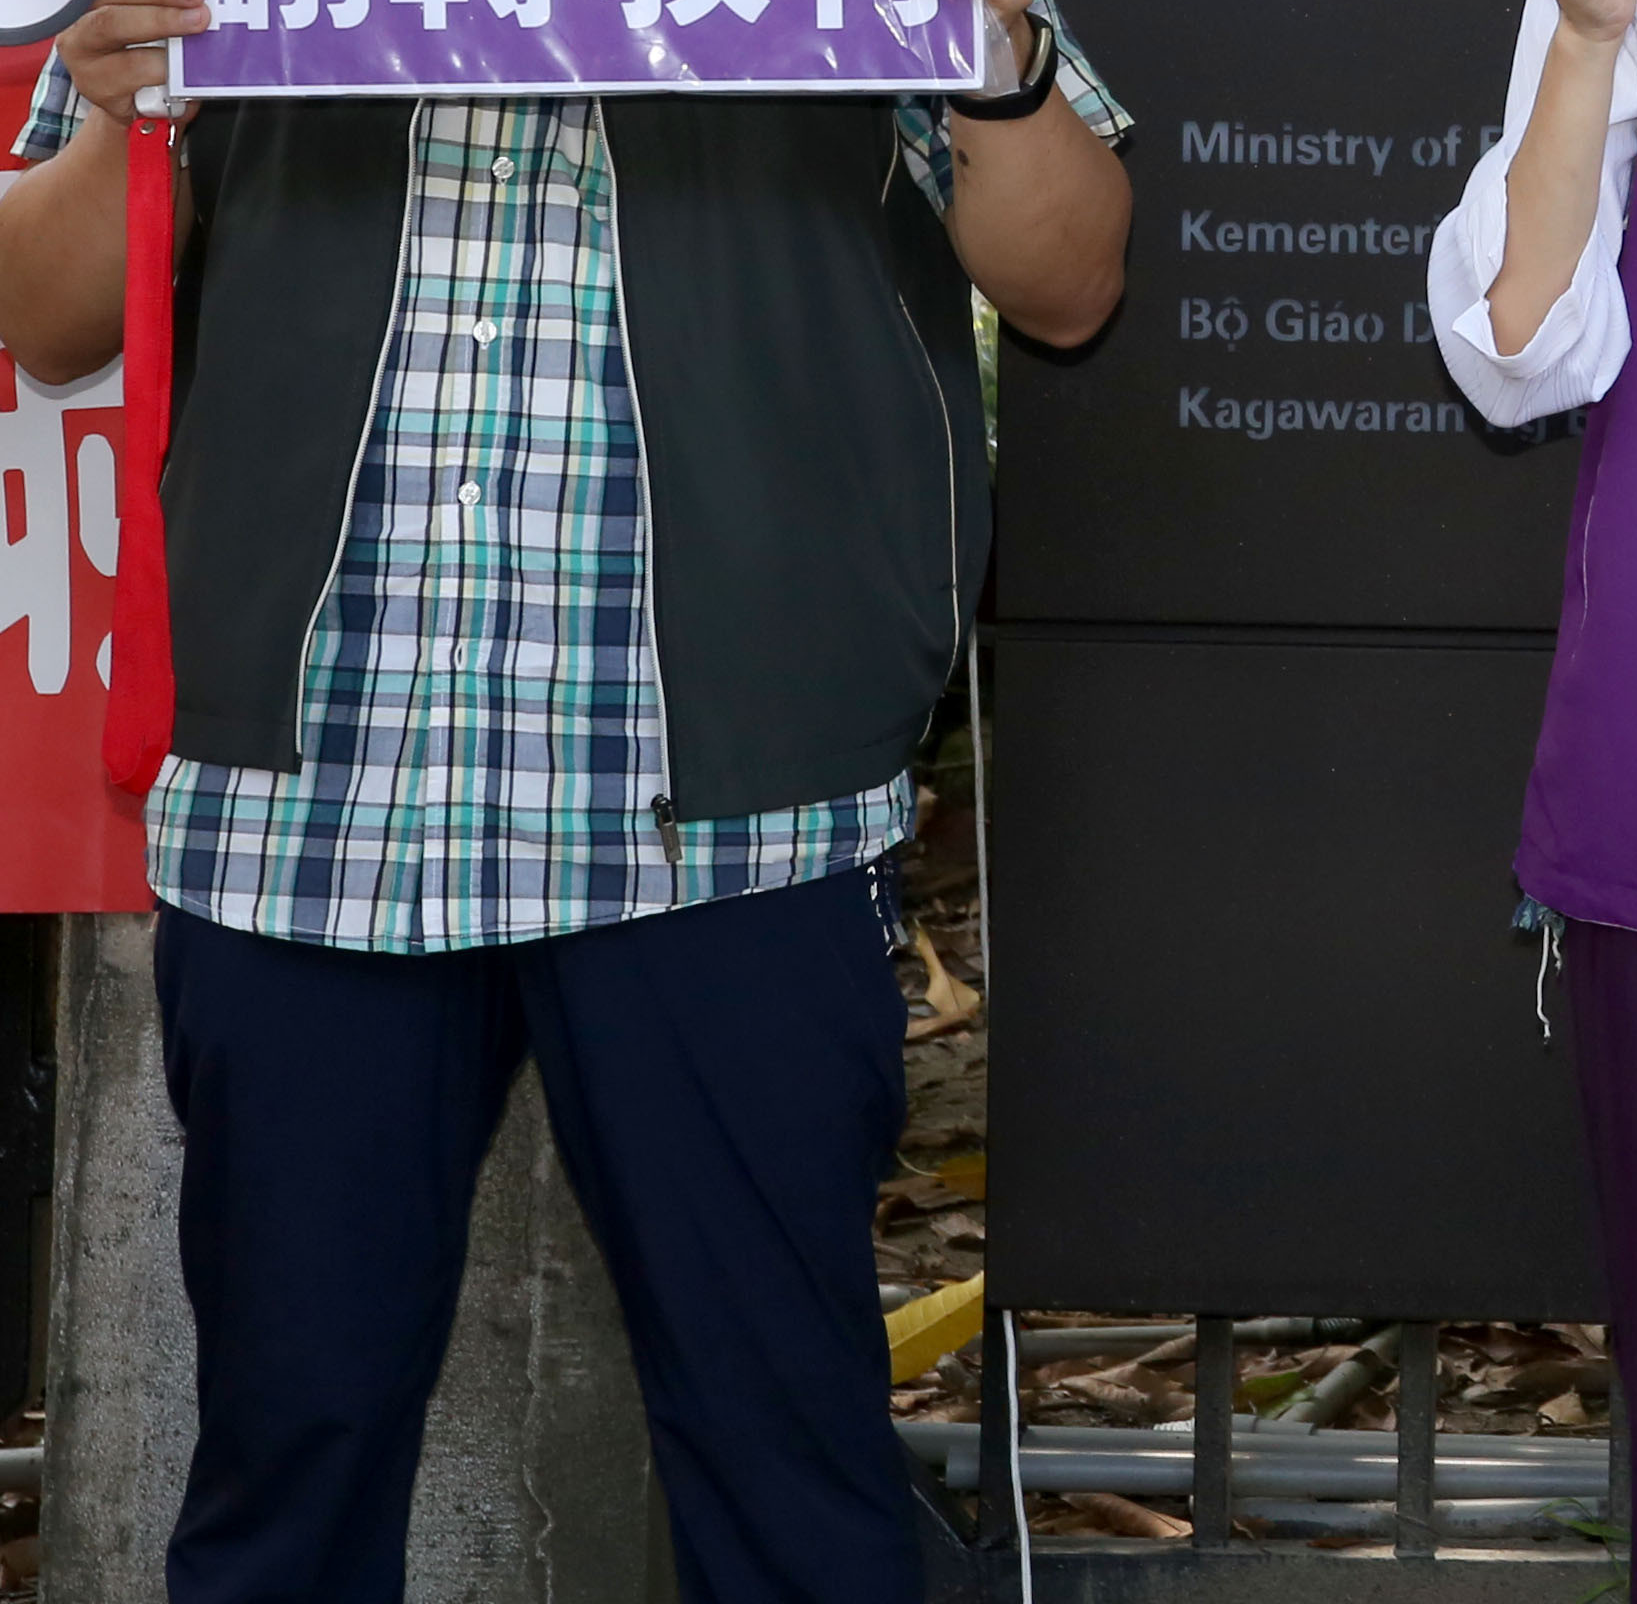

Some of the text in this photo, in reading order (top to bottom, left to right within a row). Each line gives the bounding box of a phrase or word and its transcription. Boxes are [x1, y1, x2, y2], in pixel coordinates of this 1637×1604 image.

[1182, 121, 1393, 176] Ministry
[1411, 125, 1462, 167] of
[1180, 210, 1441, 255] Kementer
[1180, 296, 1249, 353] Bộ
[1264, 298, 1385, 344] Giáo
[1178, 385, 1465, 440] Kagawaran
